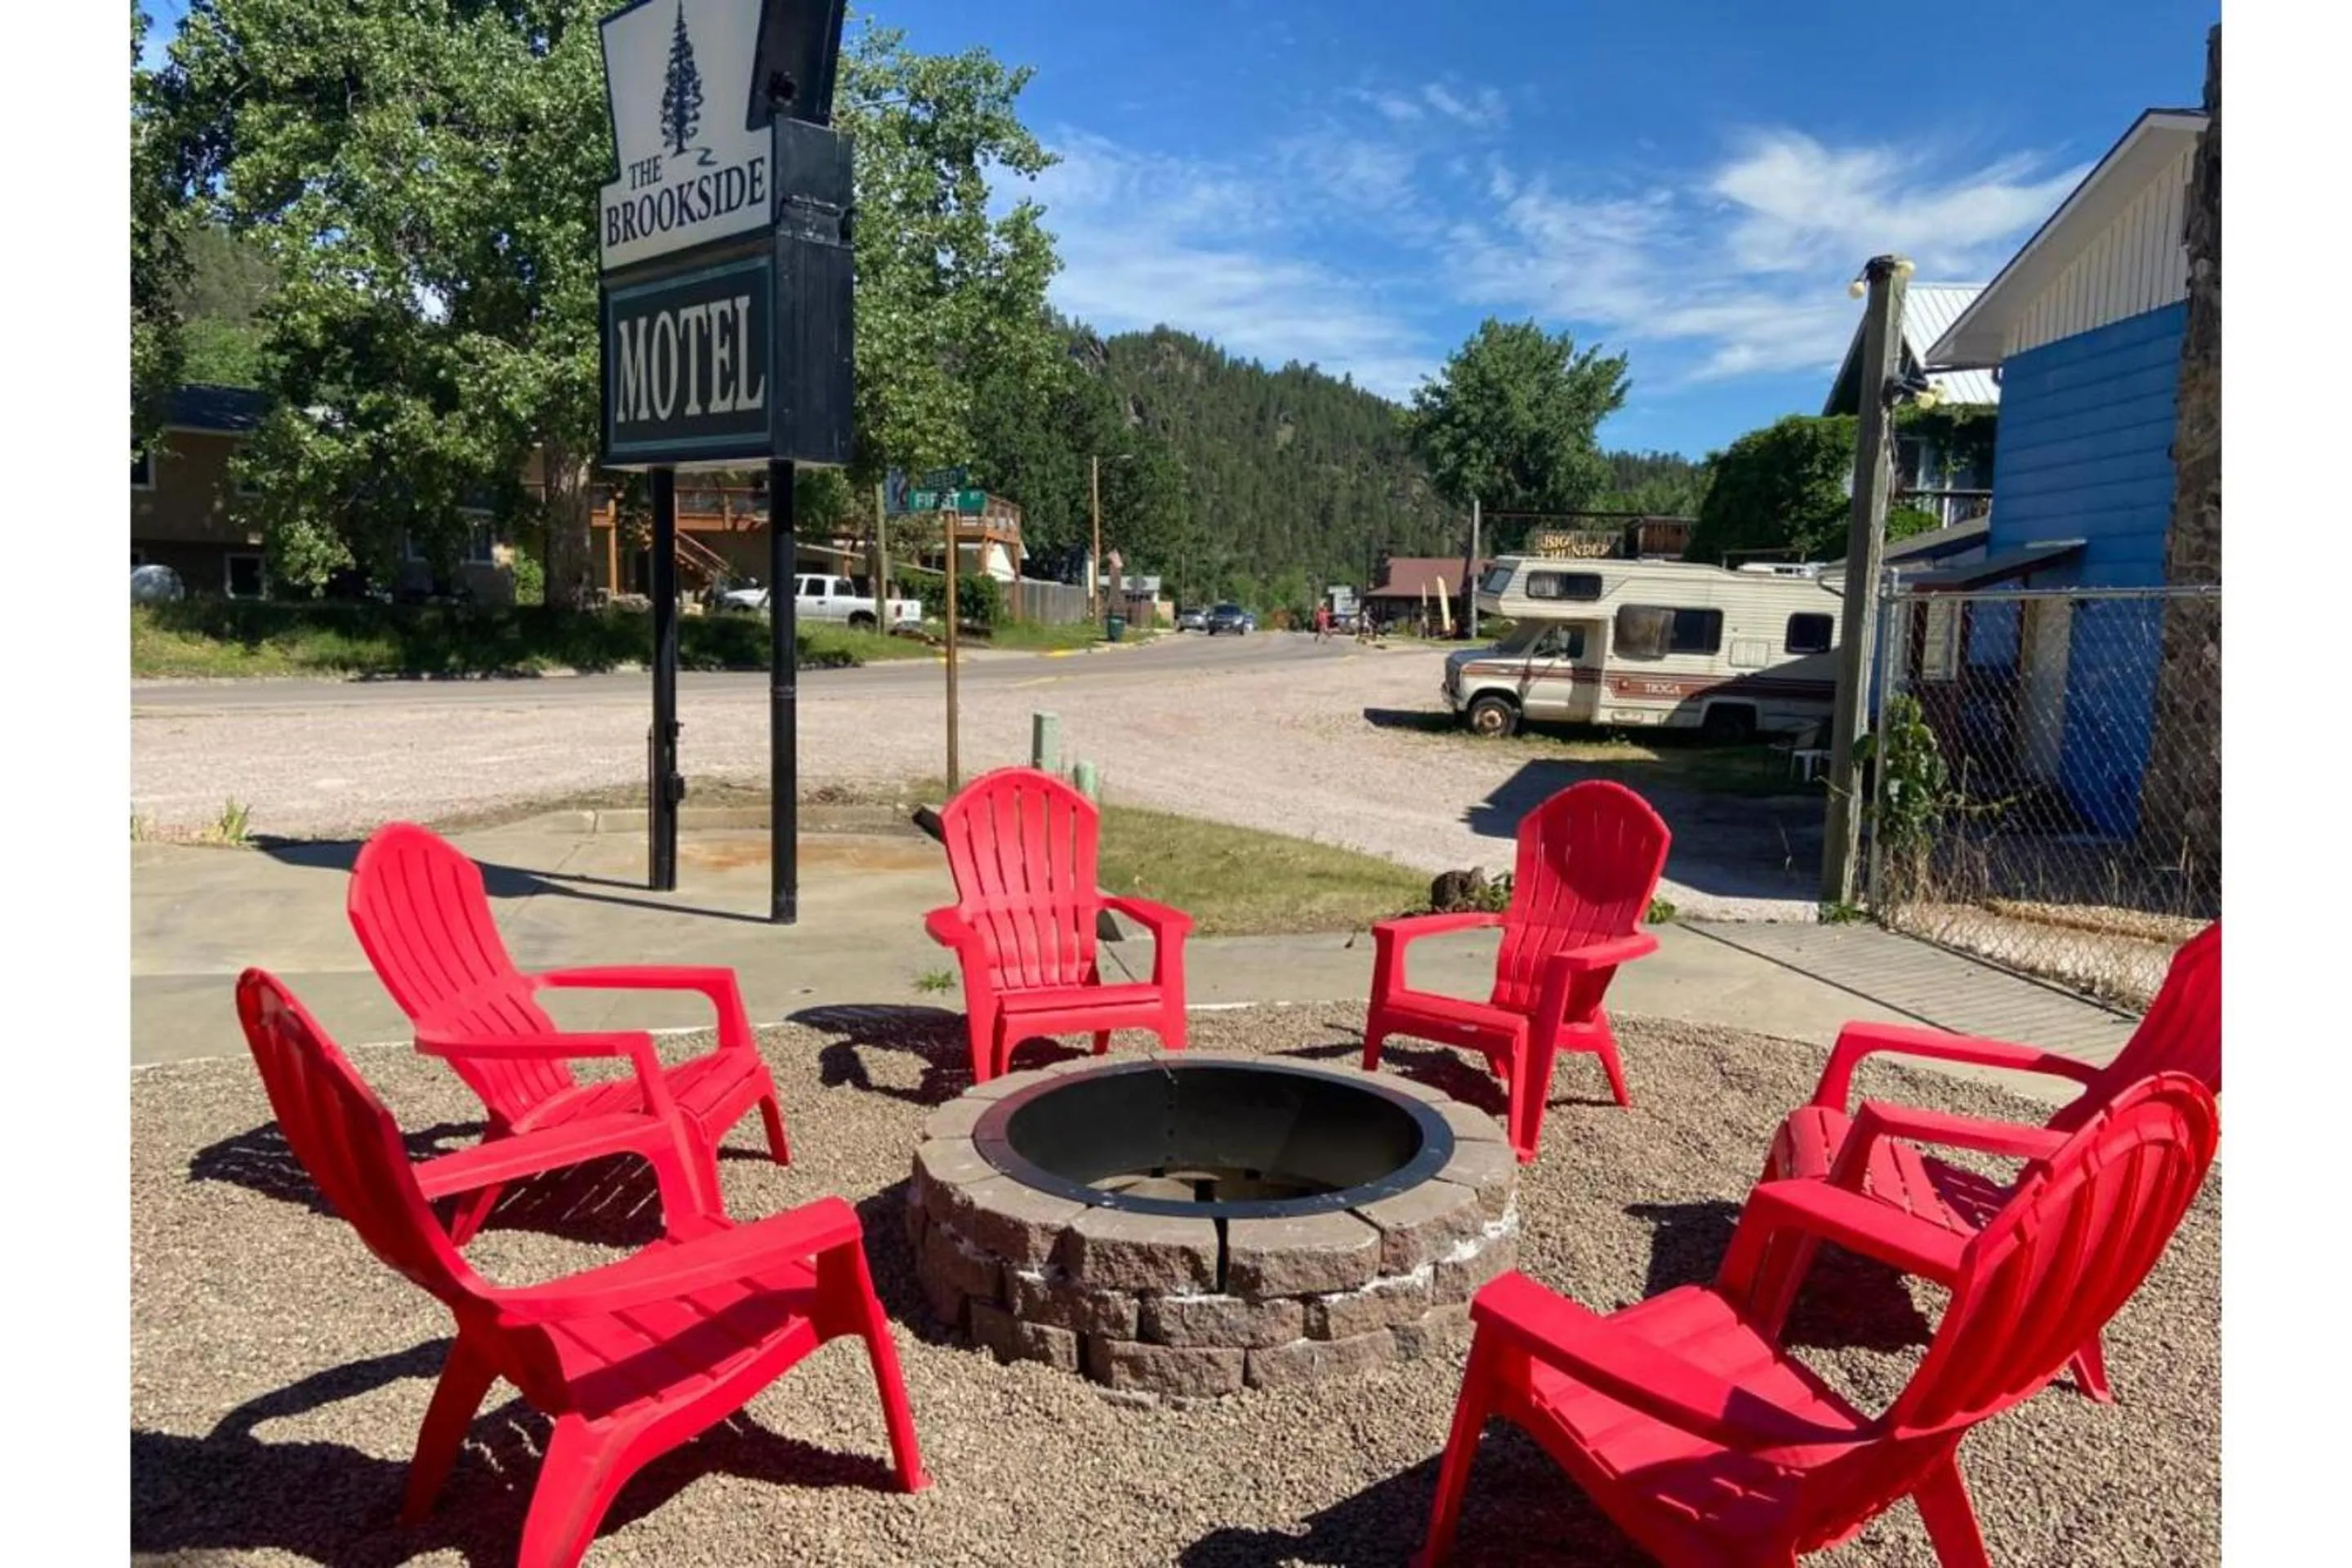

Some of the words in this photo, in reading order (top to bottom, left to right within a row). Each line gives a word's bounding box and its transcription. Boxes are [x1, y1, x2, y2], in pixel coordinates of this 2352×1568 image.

[605, 157, 766, 248] BROOKSIDE
[628, 154, 663, 191] THE
[616, 295, 766, 423] MOTEL
